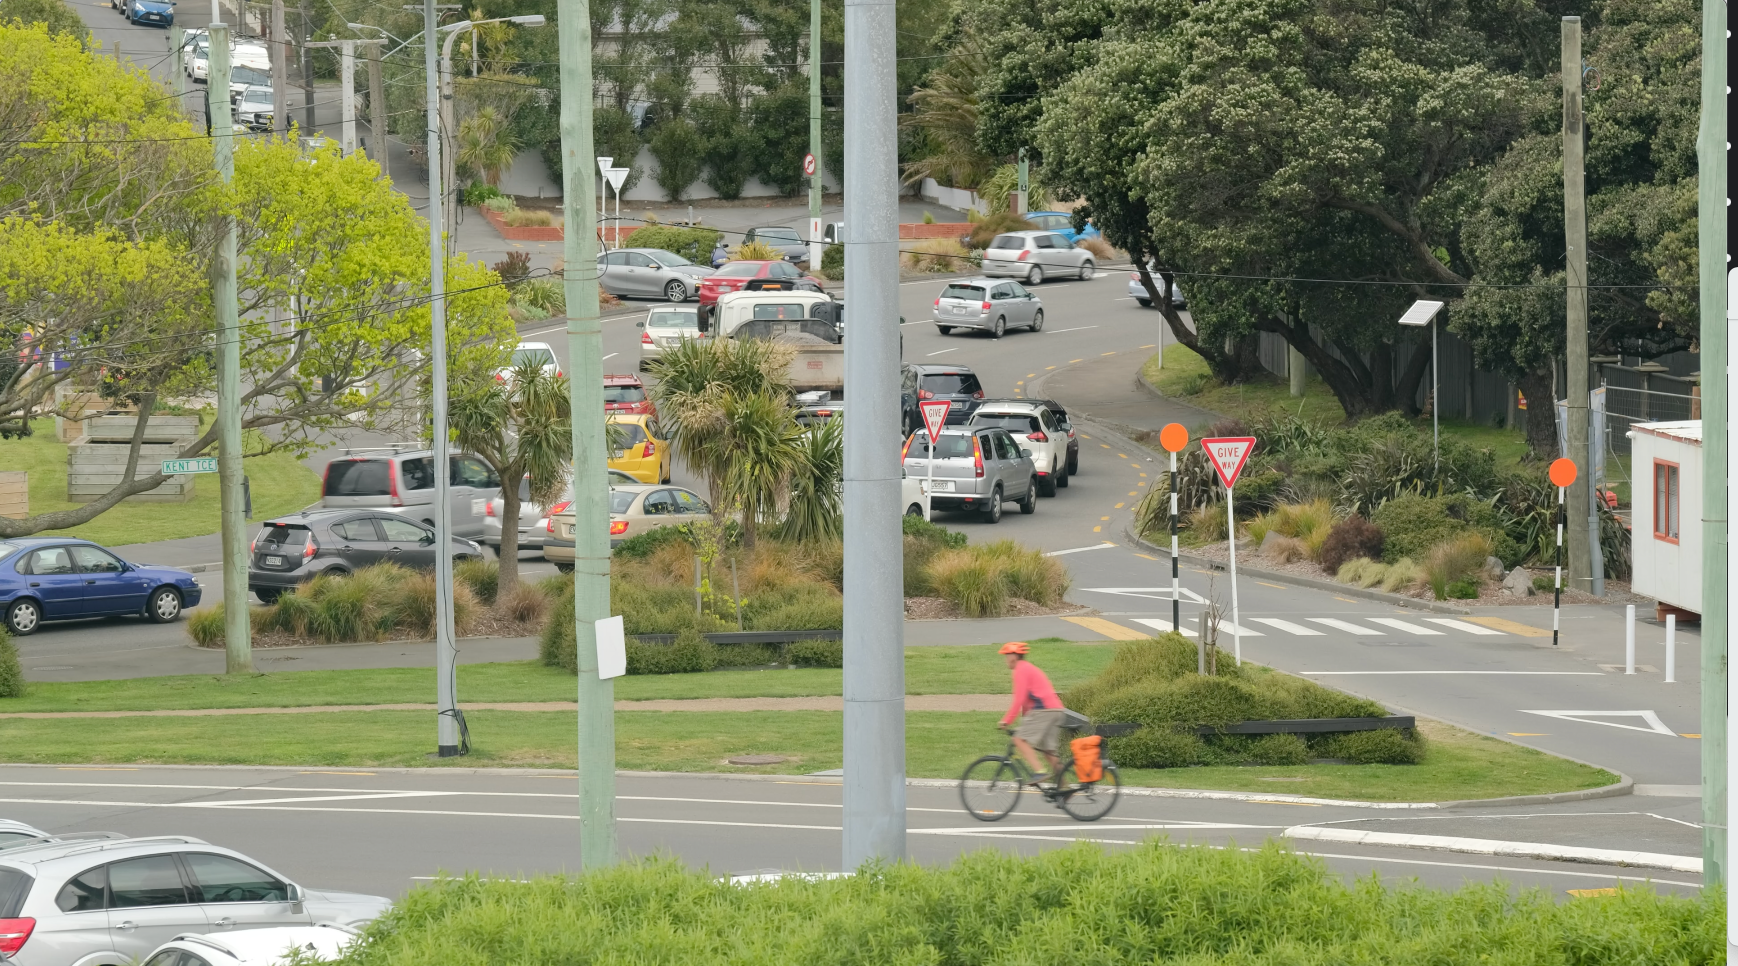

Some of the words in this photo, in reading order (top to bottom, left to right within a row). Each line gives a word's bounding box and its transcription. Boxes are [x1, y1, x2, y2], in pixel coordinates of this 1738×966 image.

[928, 408, 942, 418] GIVE
[930, 420, 940, 428] WAY
[1217, 447, 1240, 458] GIVE
[165, 461, 190, 472] KENT
[196, 460, 213, 470] TCE
[1221, 461, 1236, 470] WAY
